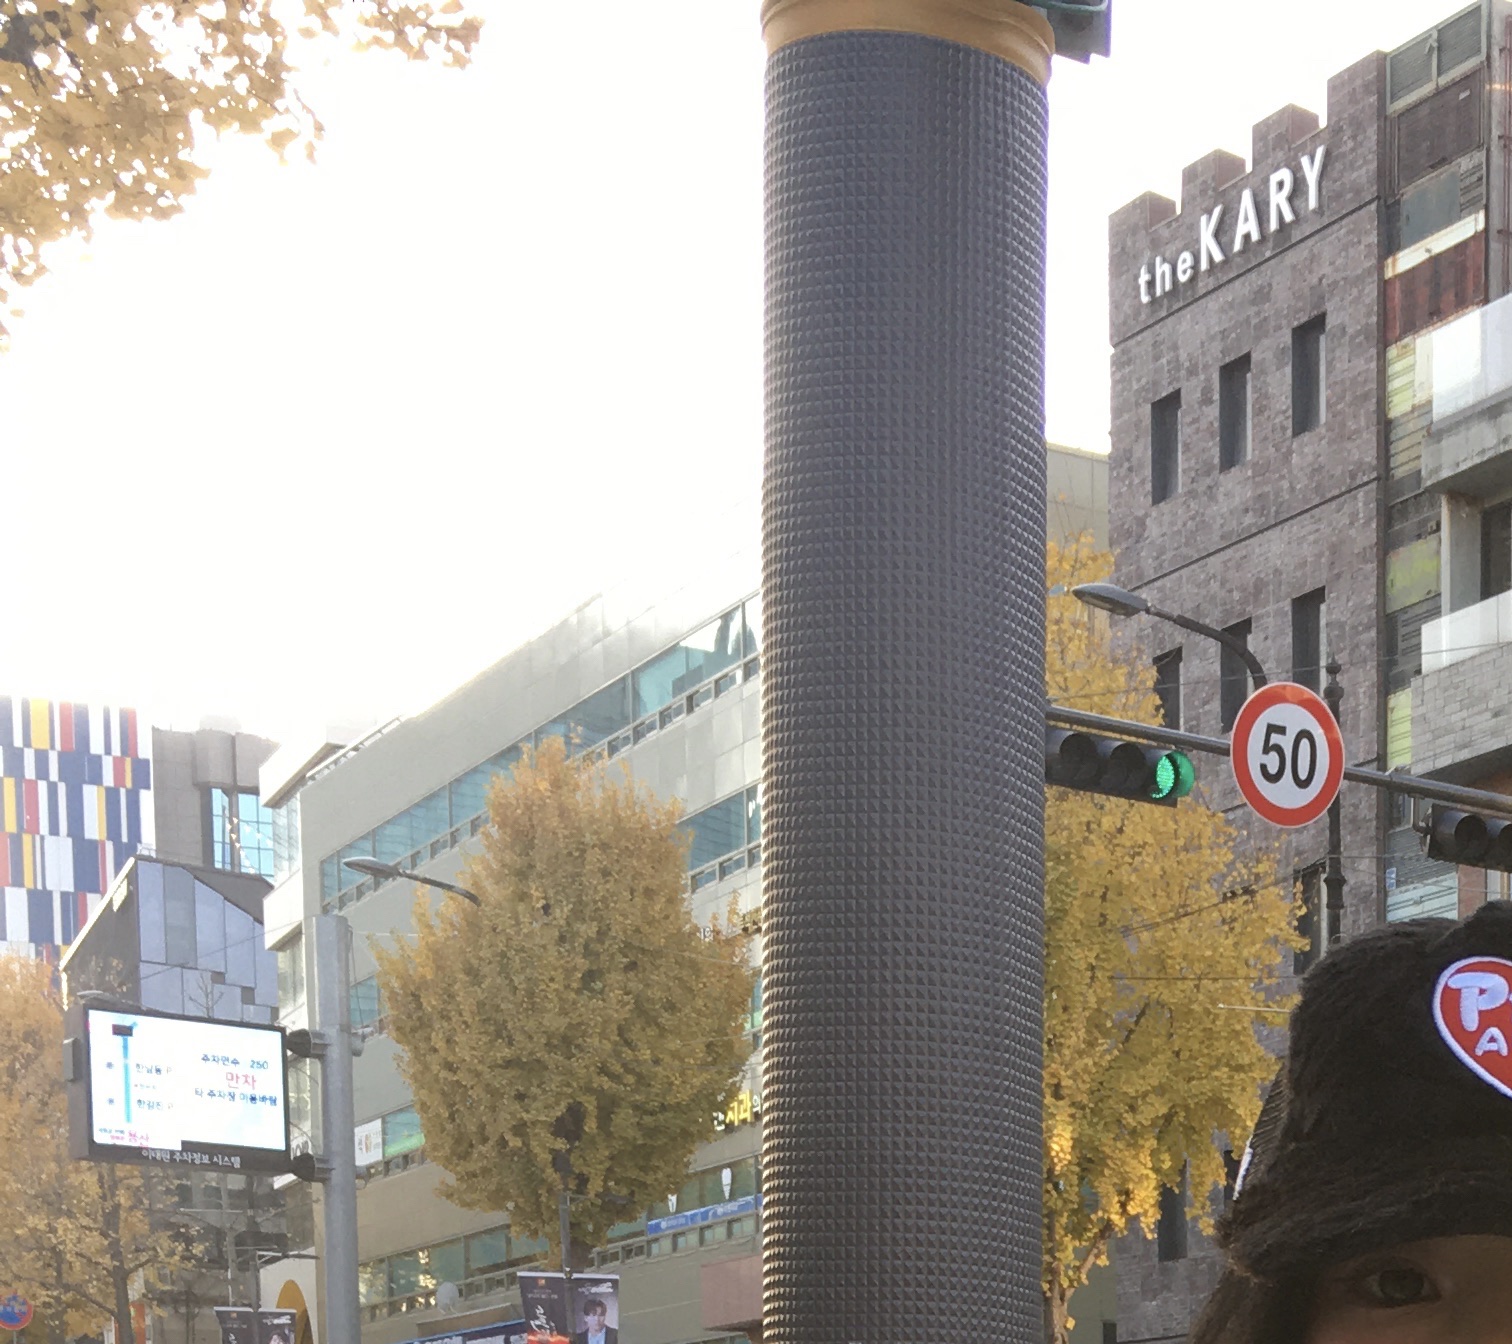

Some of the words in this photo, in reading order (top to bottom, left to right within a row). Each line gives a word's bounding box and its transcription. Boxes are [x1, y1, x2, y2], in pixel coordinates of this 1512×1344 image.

[1260, 722, 1317, 790] 50
[249, 1059, 269, 1070] 250
[225, 1071, 257, 1090] 만차
